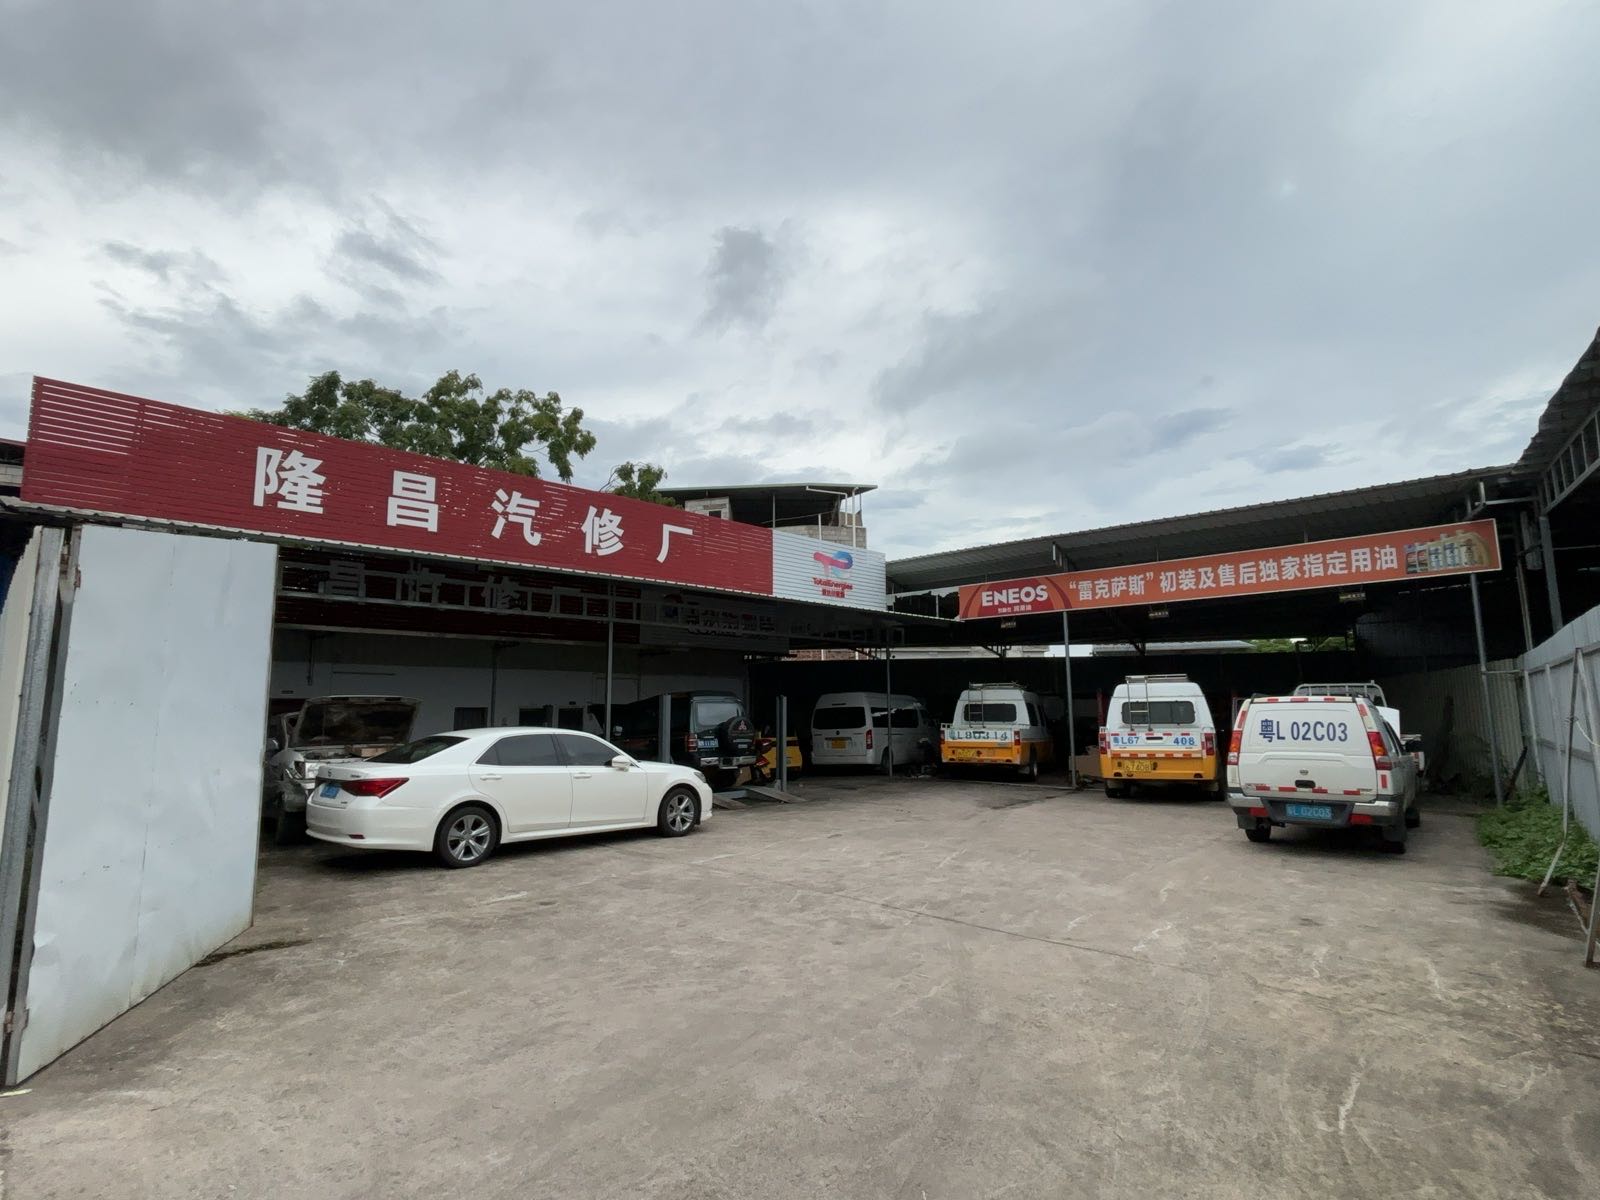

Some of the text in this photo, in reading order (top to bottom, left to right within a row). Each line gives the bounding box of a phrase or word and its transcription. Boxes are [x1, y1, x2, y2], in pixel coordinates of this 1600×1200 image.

[253, 446, 693, 564] 隆昌汽修厂
[981, 584, 1048, 607] ENEOS
[1173, 737, 1195, 746] 408
